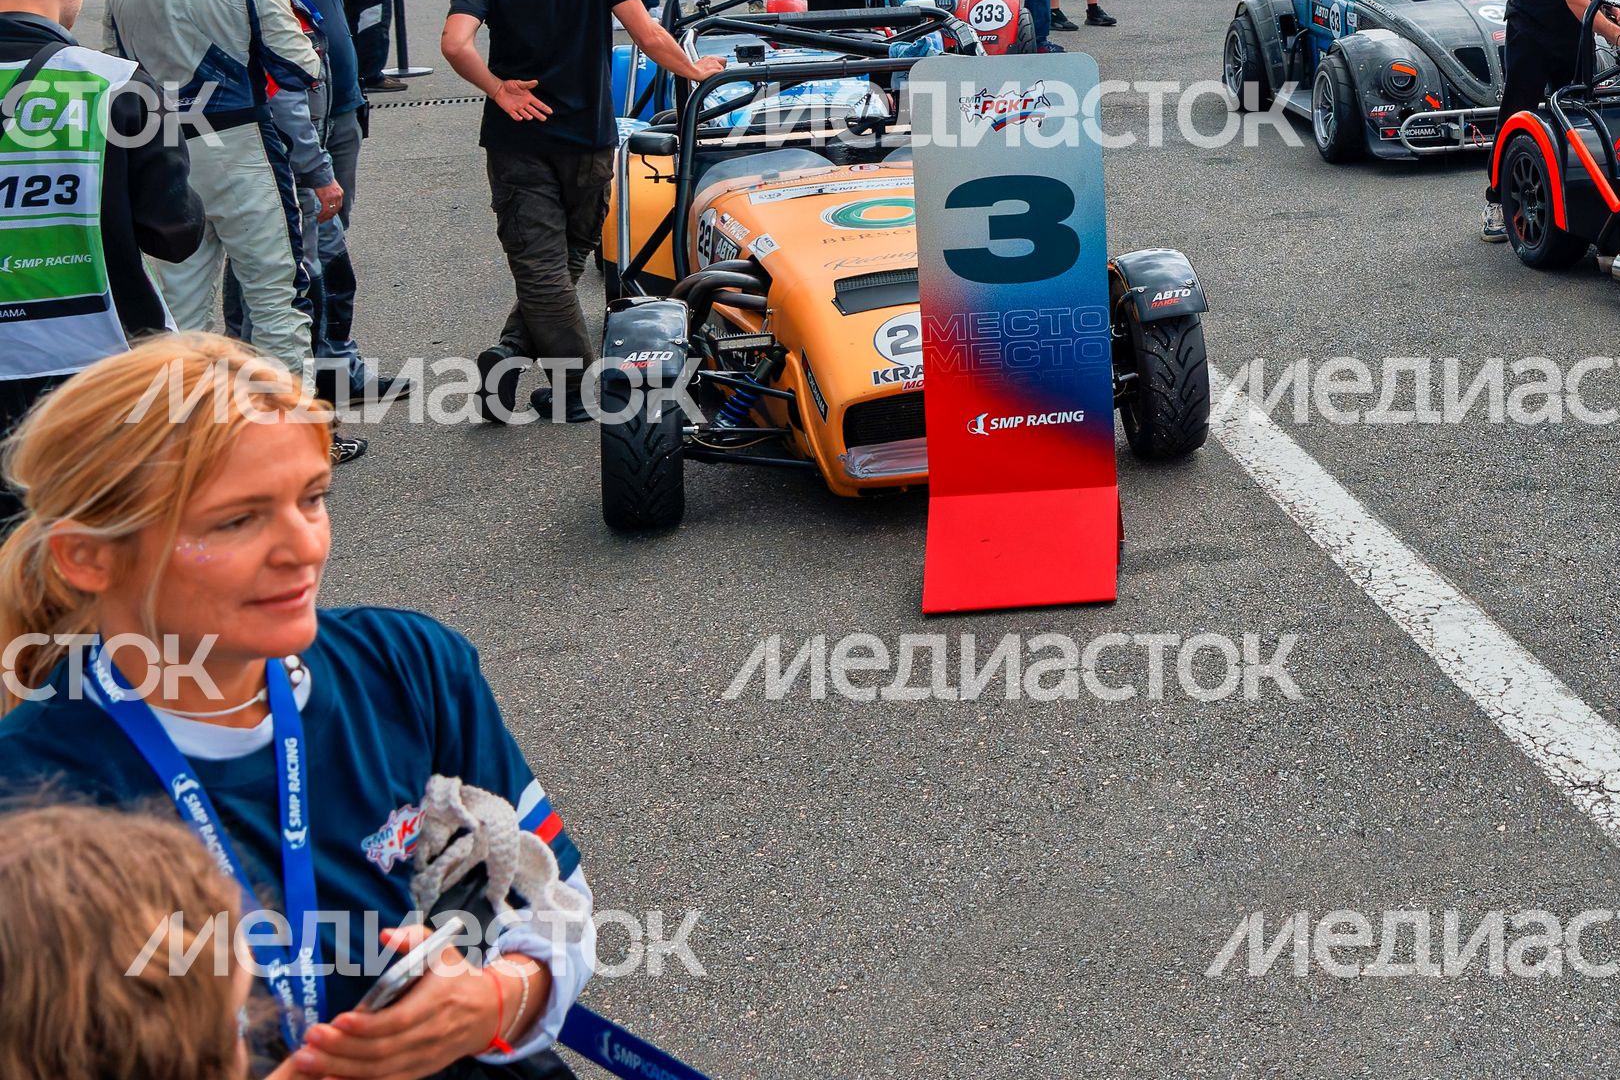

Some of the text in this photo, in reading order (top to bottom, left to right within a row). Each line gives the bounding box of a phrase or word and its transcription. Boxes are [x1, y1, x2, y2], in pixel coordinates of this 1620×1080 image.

[974, 4, 1005, 25] 333
[1314, 5, 1329, 19] АВТО
[1330, 9, 1341, 32] 33
[958, 95, 981, 104] СМП
[981, 97, 1035, 116] РСКГ
[1370, 104, 1396, 113] АВТО
[1397, 127, 1436, 136] YKOHAMA
[0, 174, 81, 209] 123
[822, 229, 912, 245] BERSO
[942, 174, 1081, 285] 3
[13, 254, 92, 270] SMP RACING
[1151, 297, 1180, 308] ПЛЮС
[1152, 288, 1192, 303] АВТО
[921, 305, 1110, 343] МЕСТО
[886, 324, 922, 357] 2
[624, 351, 674, 364] АВТО
[922, 336, 1112, 373] МЕСТО
[989, 410, 1085, 430] SMP RACING
[284, 737, 302, 827] SMP RACING
[184, 793, 234, 877] SMP RACING
[361, 829, 395, 851] СМП
